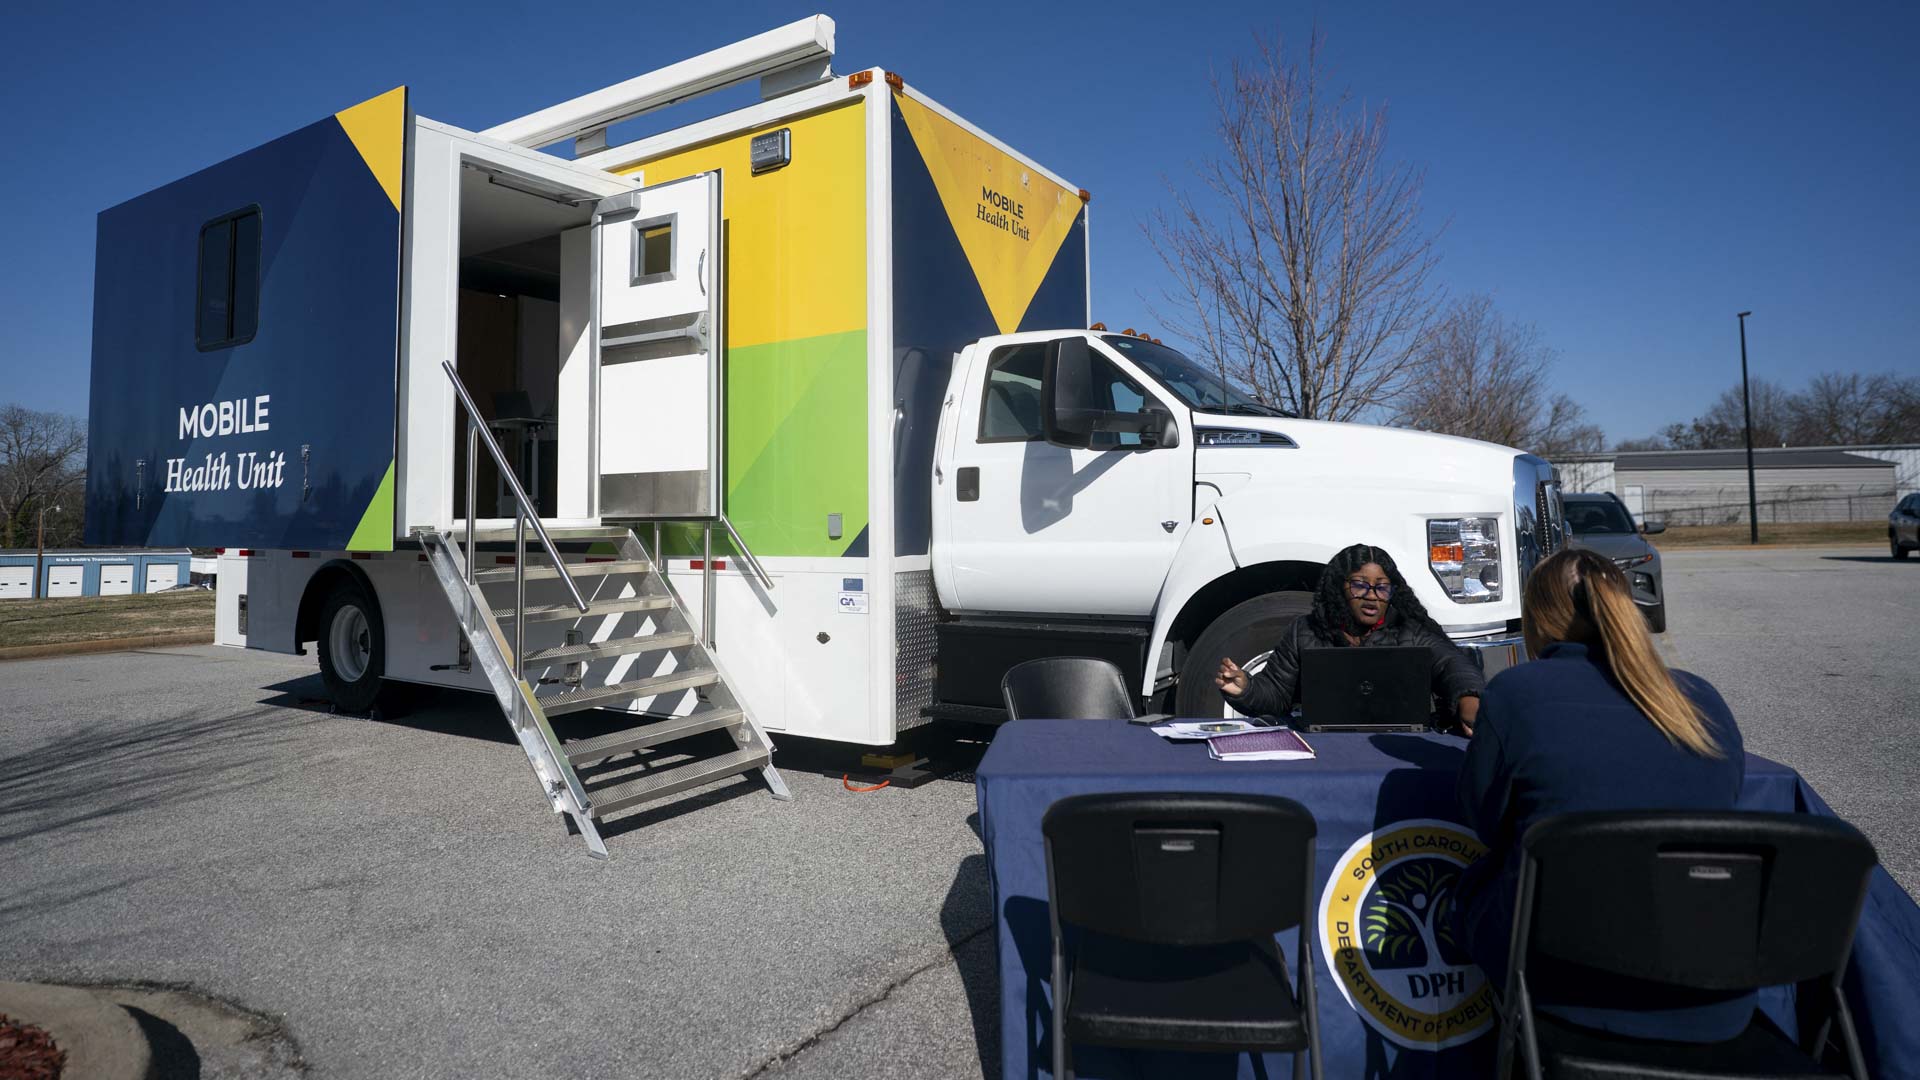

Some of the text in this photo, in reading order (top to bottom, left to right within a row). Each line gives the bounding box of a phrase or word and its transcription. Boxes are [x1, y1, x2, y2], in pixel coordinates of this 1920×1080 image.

[976, 202, 1030, 241] Health Unit
[982, 185, 1024, 220] MOBILE
[179, 395, 270, 440] MOBILE
[164, 450, 286, 492] Health Unit
[1353, 835, 1482, 880] SOUTH CAROLIN
[1336, 921, 1421, 1032] DEPARTMENT
[1424, 1020, 1442, 1034] OF
[1407, 971, 1465, 999] DPH
